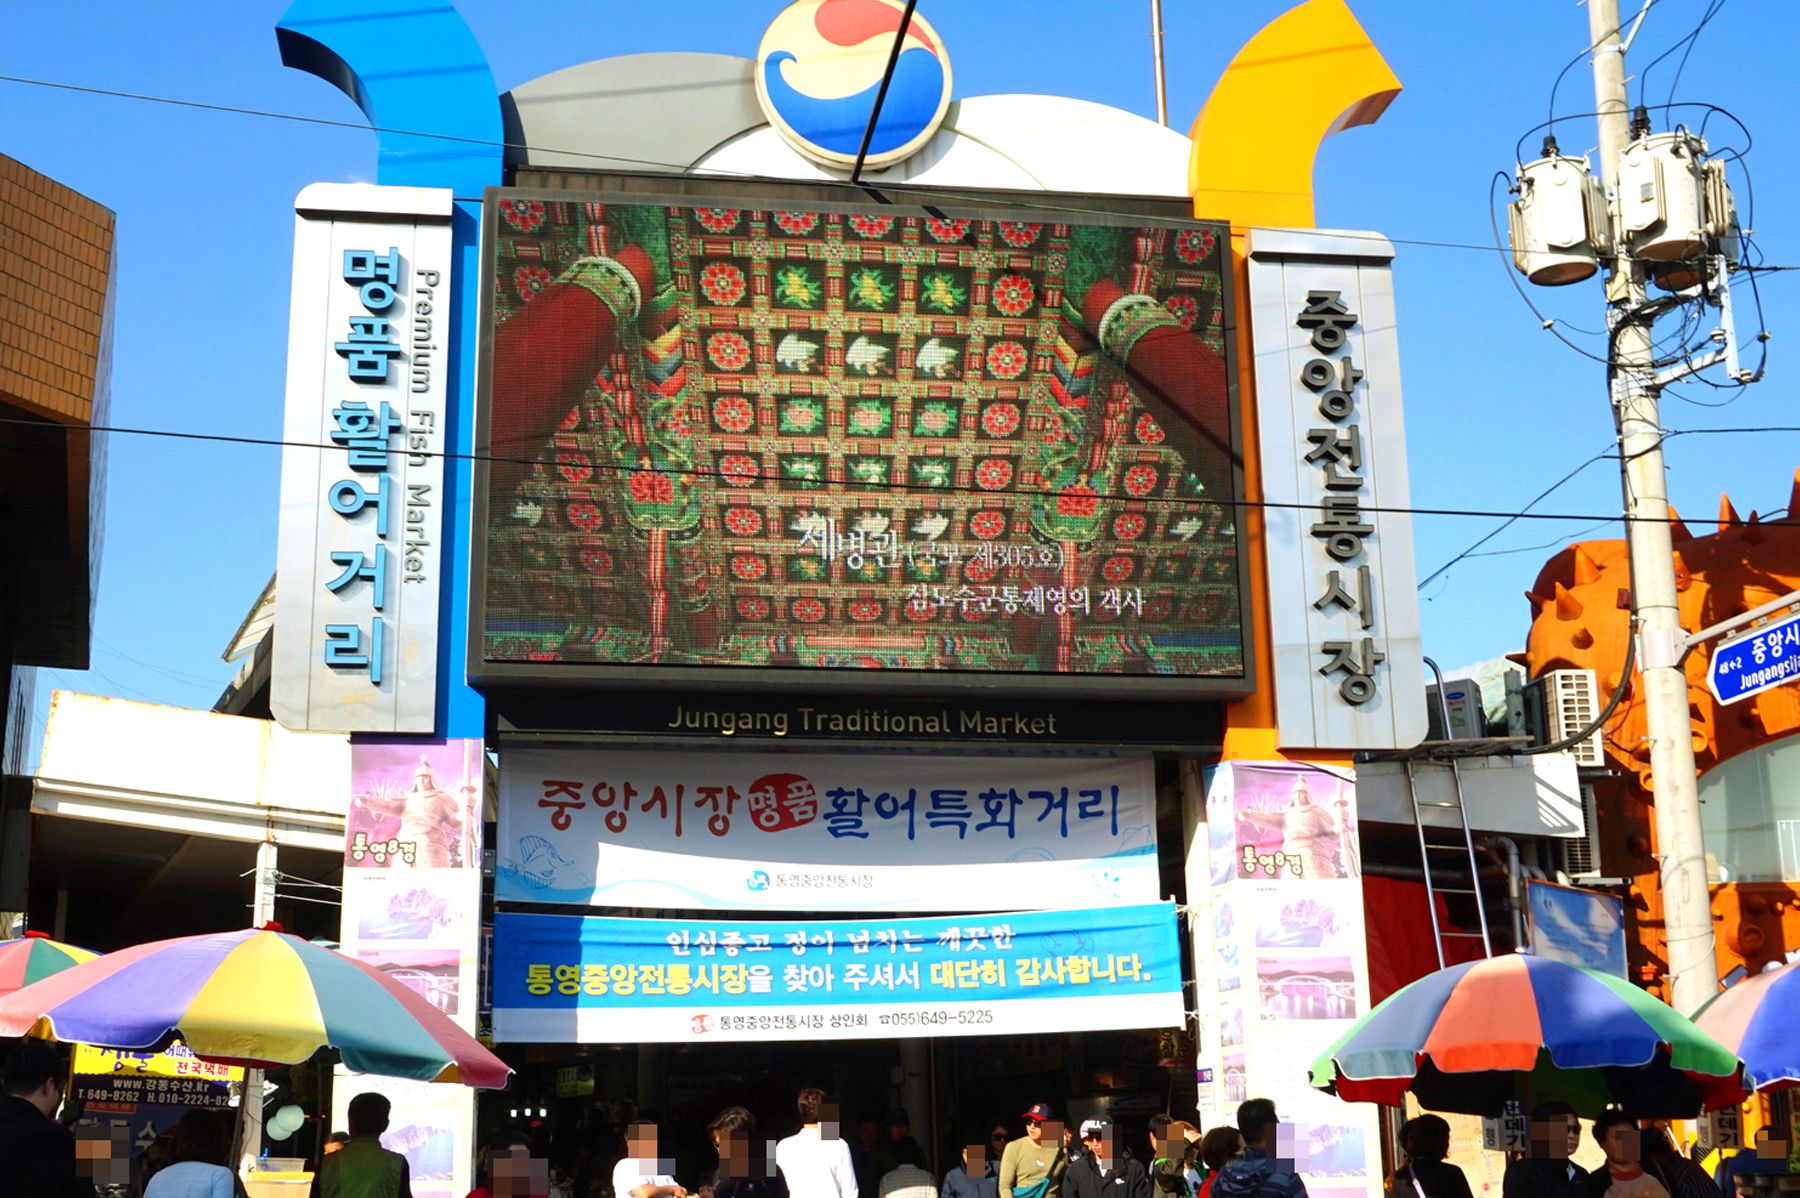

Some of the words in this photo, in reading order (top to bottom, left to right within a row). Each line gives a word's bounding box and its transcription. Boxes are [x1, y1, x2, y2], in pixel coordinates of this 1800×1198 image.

[411, 269, 440, 394] Premium
[408, 410, 435, 468] Fish
[1296, 290, 1385, 704] 중앙전통시장
[404, 484, 432, 585] Market
[667, 704, 789, 736] Jungang
[797, 706, 951, 734] Traditional
[960, 709, 1057, 736] Market
[537, 779, 741, 837] 중앙시장
[350, 831, 417, 864] 통영8경
[1241, 844, 1304, 877] 통영8경
[776, 873, 874, 889] 통영중앙전통시장
[525, 963, 773, 996] 통영중앙전통시장을
[783, 963, 835, 993] 찾아
[843, 961, 920, 991] 주셔서
[930, 958, 1006, 990] 대단히
[1015, 953, 1152, 986] 감사합니다.
[719, 1014, 825, 1031] 통영중앙전통시장
[829, 1012, 868, 1028] 상인회
